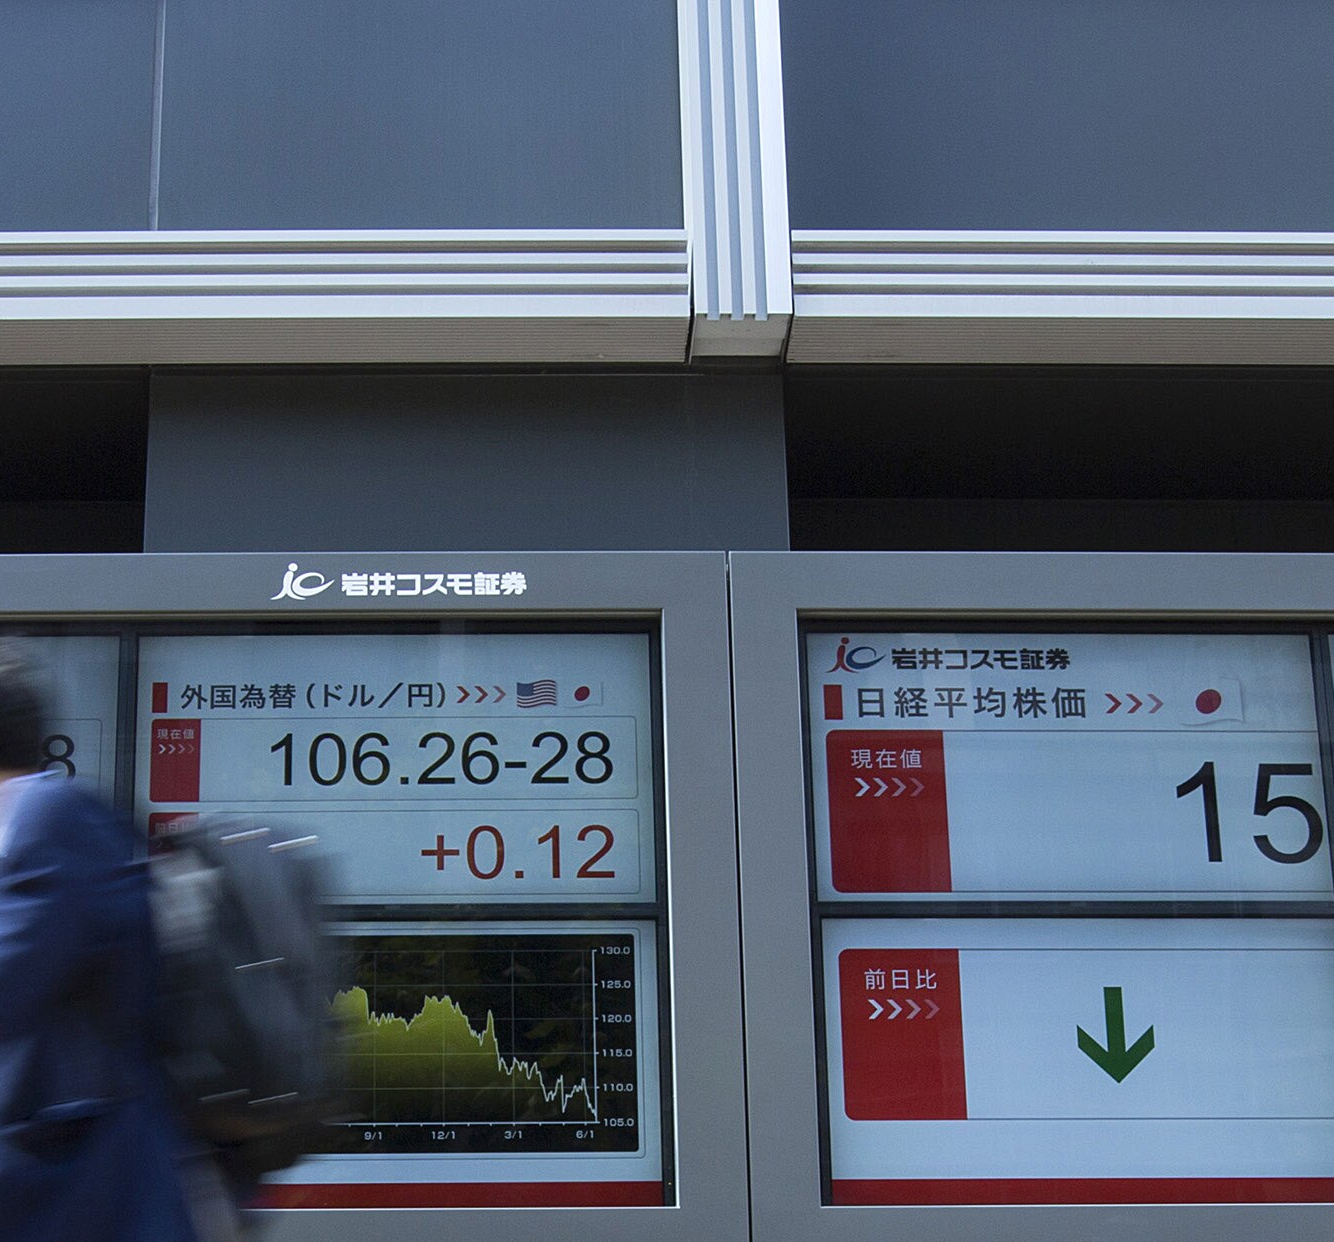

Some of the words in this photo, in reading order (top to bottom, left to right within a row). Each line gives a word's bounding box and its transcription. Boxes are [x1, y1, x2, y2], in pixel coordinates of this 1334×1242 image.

[342, 572, 528, 597] 岩井コスモ証券
[891, 648, 1071, 671] 岩井コスモ証券
[856, 687, 1087, 719] 日経平均株価
[157, 728, 195, 740] 現在値
[270, 731, 614, 787] 106.26-28
[850, 748, 923, 770] 現在値
[420, 824, 616, 880] +0.12
[599, 945, 631, 956] 130.0
[600, 979, 632, 990] 125.0
[863, 967, 939, 992] 前日比
[601, 1013, 633, 1024] 120.0
[601, 1048, 633, 1058] 115.0
[602, 1082, 634, 1093] 110.0
[603, 1117, 635, 1128] 105.0
[364, 1131, 383, 1142] 9/1
[431, 1131, 456, 1141] 12/1
[504, 1130, 524, 1141] 3/1
[575, 1130, 595, 1141] 6/1
